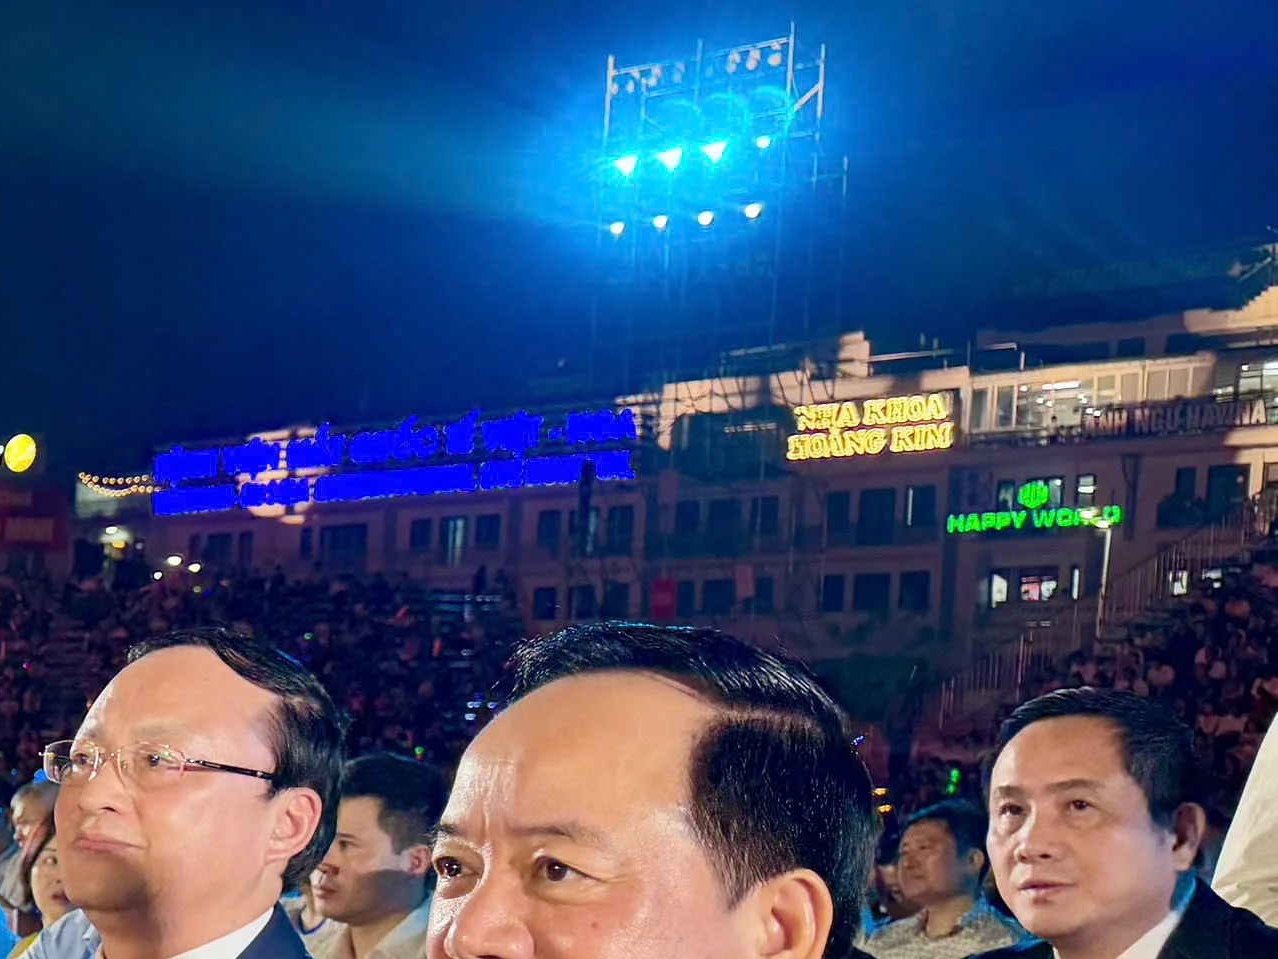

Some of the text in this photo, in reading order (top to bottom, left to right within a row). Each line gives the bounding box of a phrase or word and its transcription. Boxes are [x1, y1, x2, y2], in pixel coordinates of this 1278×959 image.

[862, 393, 950, 426] KHOA
[889, 421, 954, 453] KIM
[946, 505, 1121, 533] HAPPY WORD
